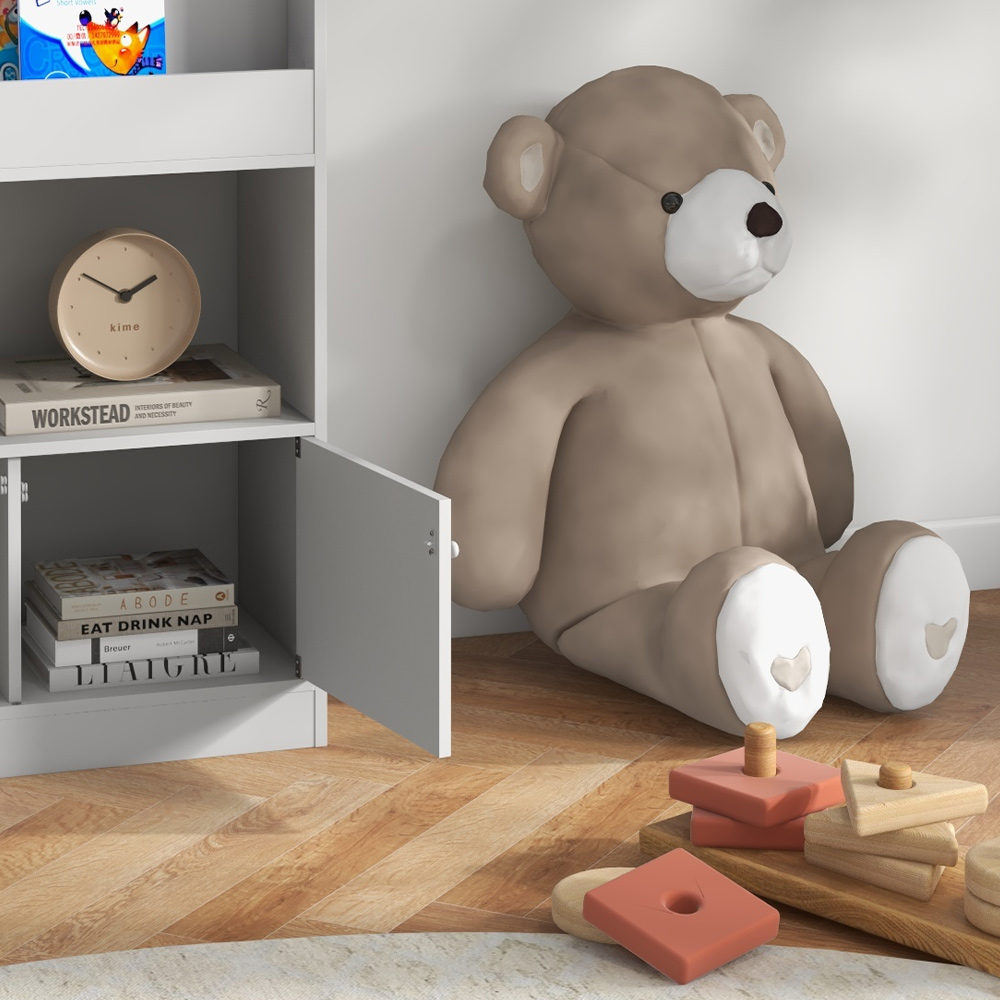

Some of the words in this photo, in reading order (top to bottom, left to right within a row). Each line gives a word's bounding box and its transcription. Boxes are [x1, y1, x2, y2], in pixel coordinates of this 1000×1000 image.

[110, 322, 140, 332] kime
[172, 401, 192, 409] BEAUTY
[32, 403, 130, 428] WORKSTEAD
[121, 592, 188, 610] ABODE
[81, 622, 112, 635] EAT
[118, 617, 172, 632] DRINK
[178, 613, 213, 627] NAP
[104, 644, 130, 652] Breuer
[76, 652, 236, 686] LIAIGRE
